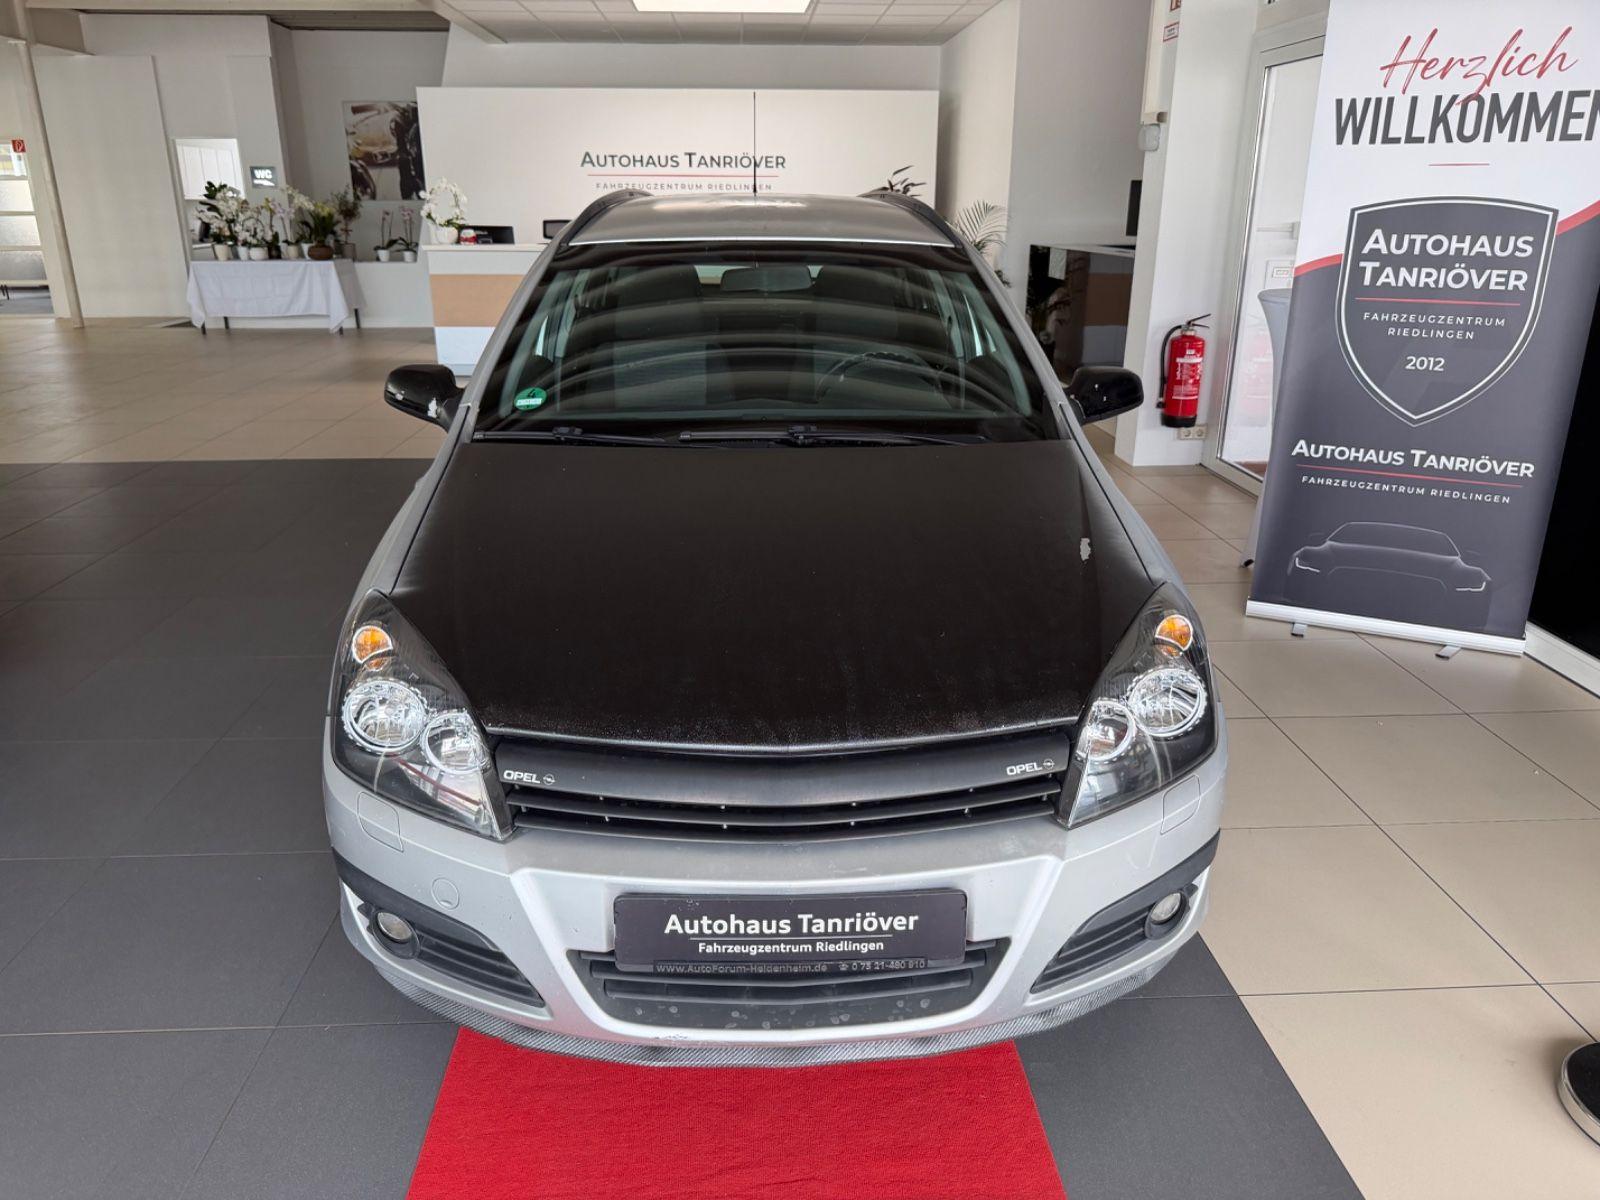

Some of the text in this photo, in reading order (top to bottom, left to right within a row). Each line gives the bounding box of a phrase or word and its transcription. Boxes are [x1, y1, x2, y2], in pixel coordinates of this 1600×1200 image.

[1379, 26, 1579, 106] Herzlich
[580, 151, 786, 169] AUTOHAUS TANRIÖVER
[253, 168, 273, 179] WC
[1361, 228, 1535, 258] AUTOHAUS
[1358, 261, 1528, 291] TANRIÖVER
[1362, 311, 1506, 327] FAHRZEUGZENTRUM
[1387, 327, 1475, 340] RIEDLINGEN
[1405, 355, 1446, 372] 2012
[1291, 439, 1535, 478] AUTOHAUS TANRIÖVER
[1301, 475, 1511, 504] FAHRZEUGZENTRUM RIEDLINGEN
[503, 769, 541, 784] OPEL
[1006, 762, 1043, 776] OPEL
[664, 911, 919, 935] Autohaus Tanriöver
[698, 940, 884, 955] Fahrzeugzentrum Riedlingen
